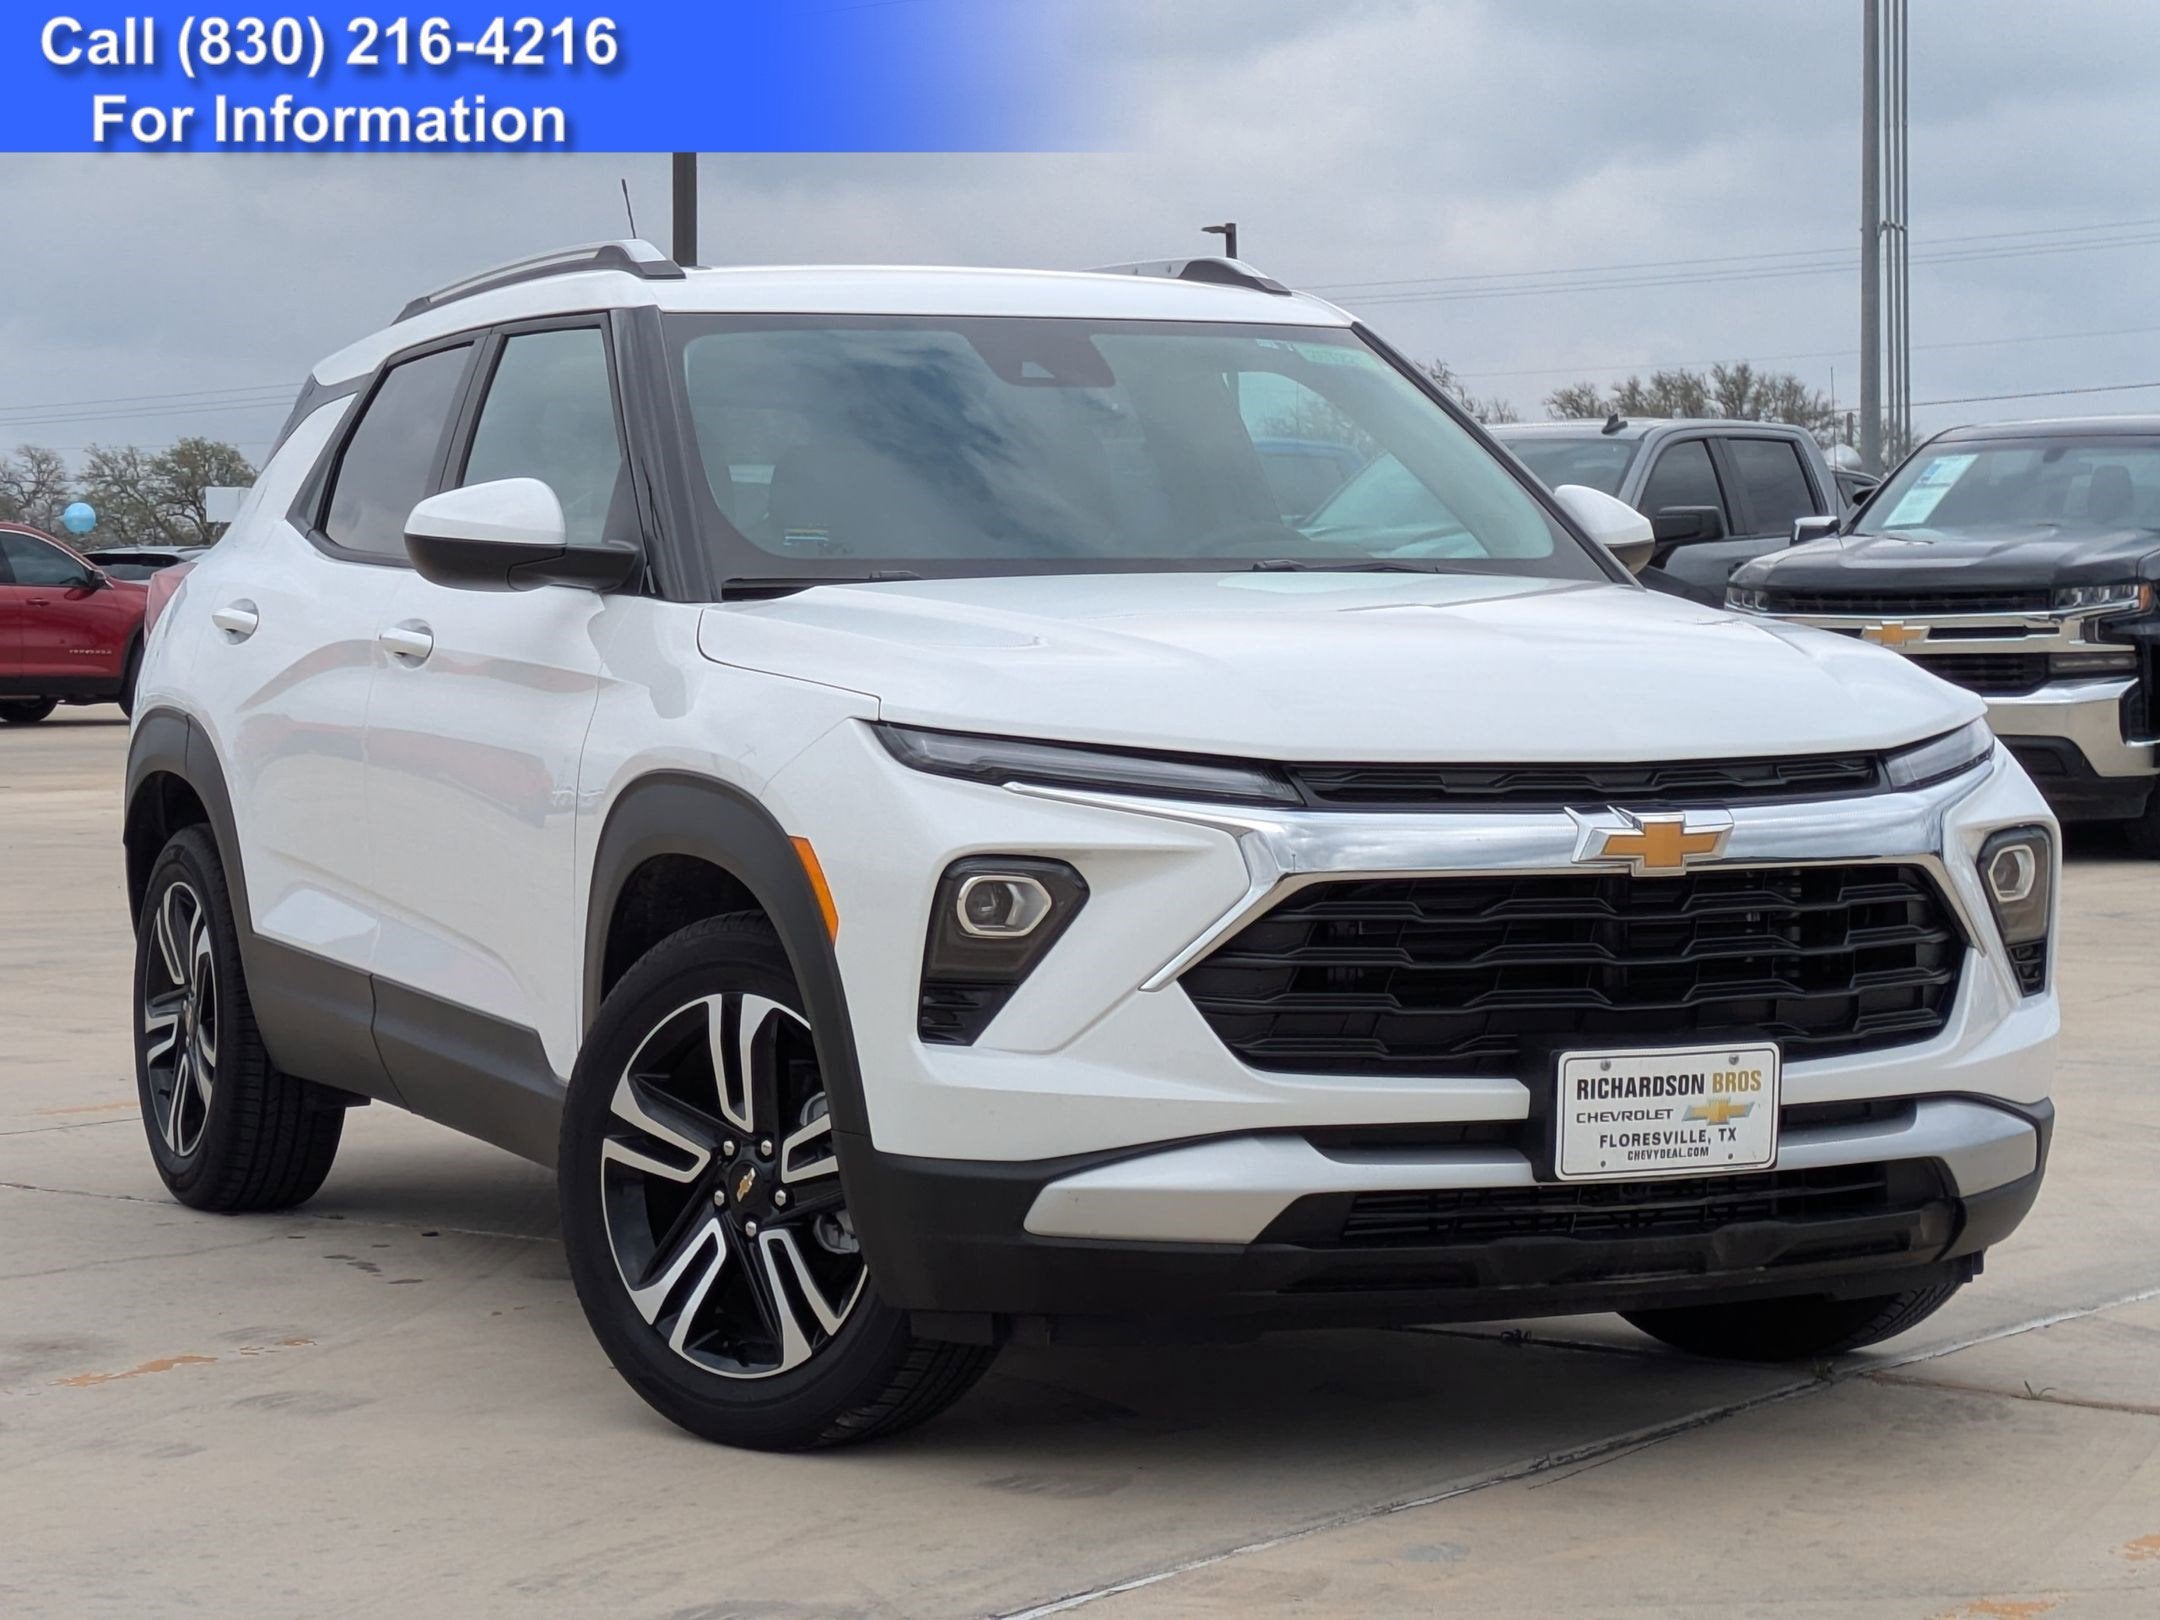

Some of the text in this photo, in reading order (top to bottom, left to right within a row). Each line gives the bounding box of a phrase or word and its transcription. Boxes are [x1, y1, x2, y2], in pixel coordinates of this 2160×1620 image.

[1576, 1070, 1762, 1100] RICHARDSON BROS
[1576, 1108, 1674, 1124] CHEVROLET
[1599, 1127, 1737, 1149] FLORESVILLE, TX
[1627, 1146, 1710, 1161] CHEVYDEAL.COM
